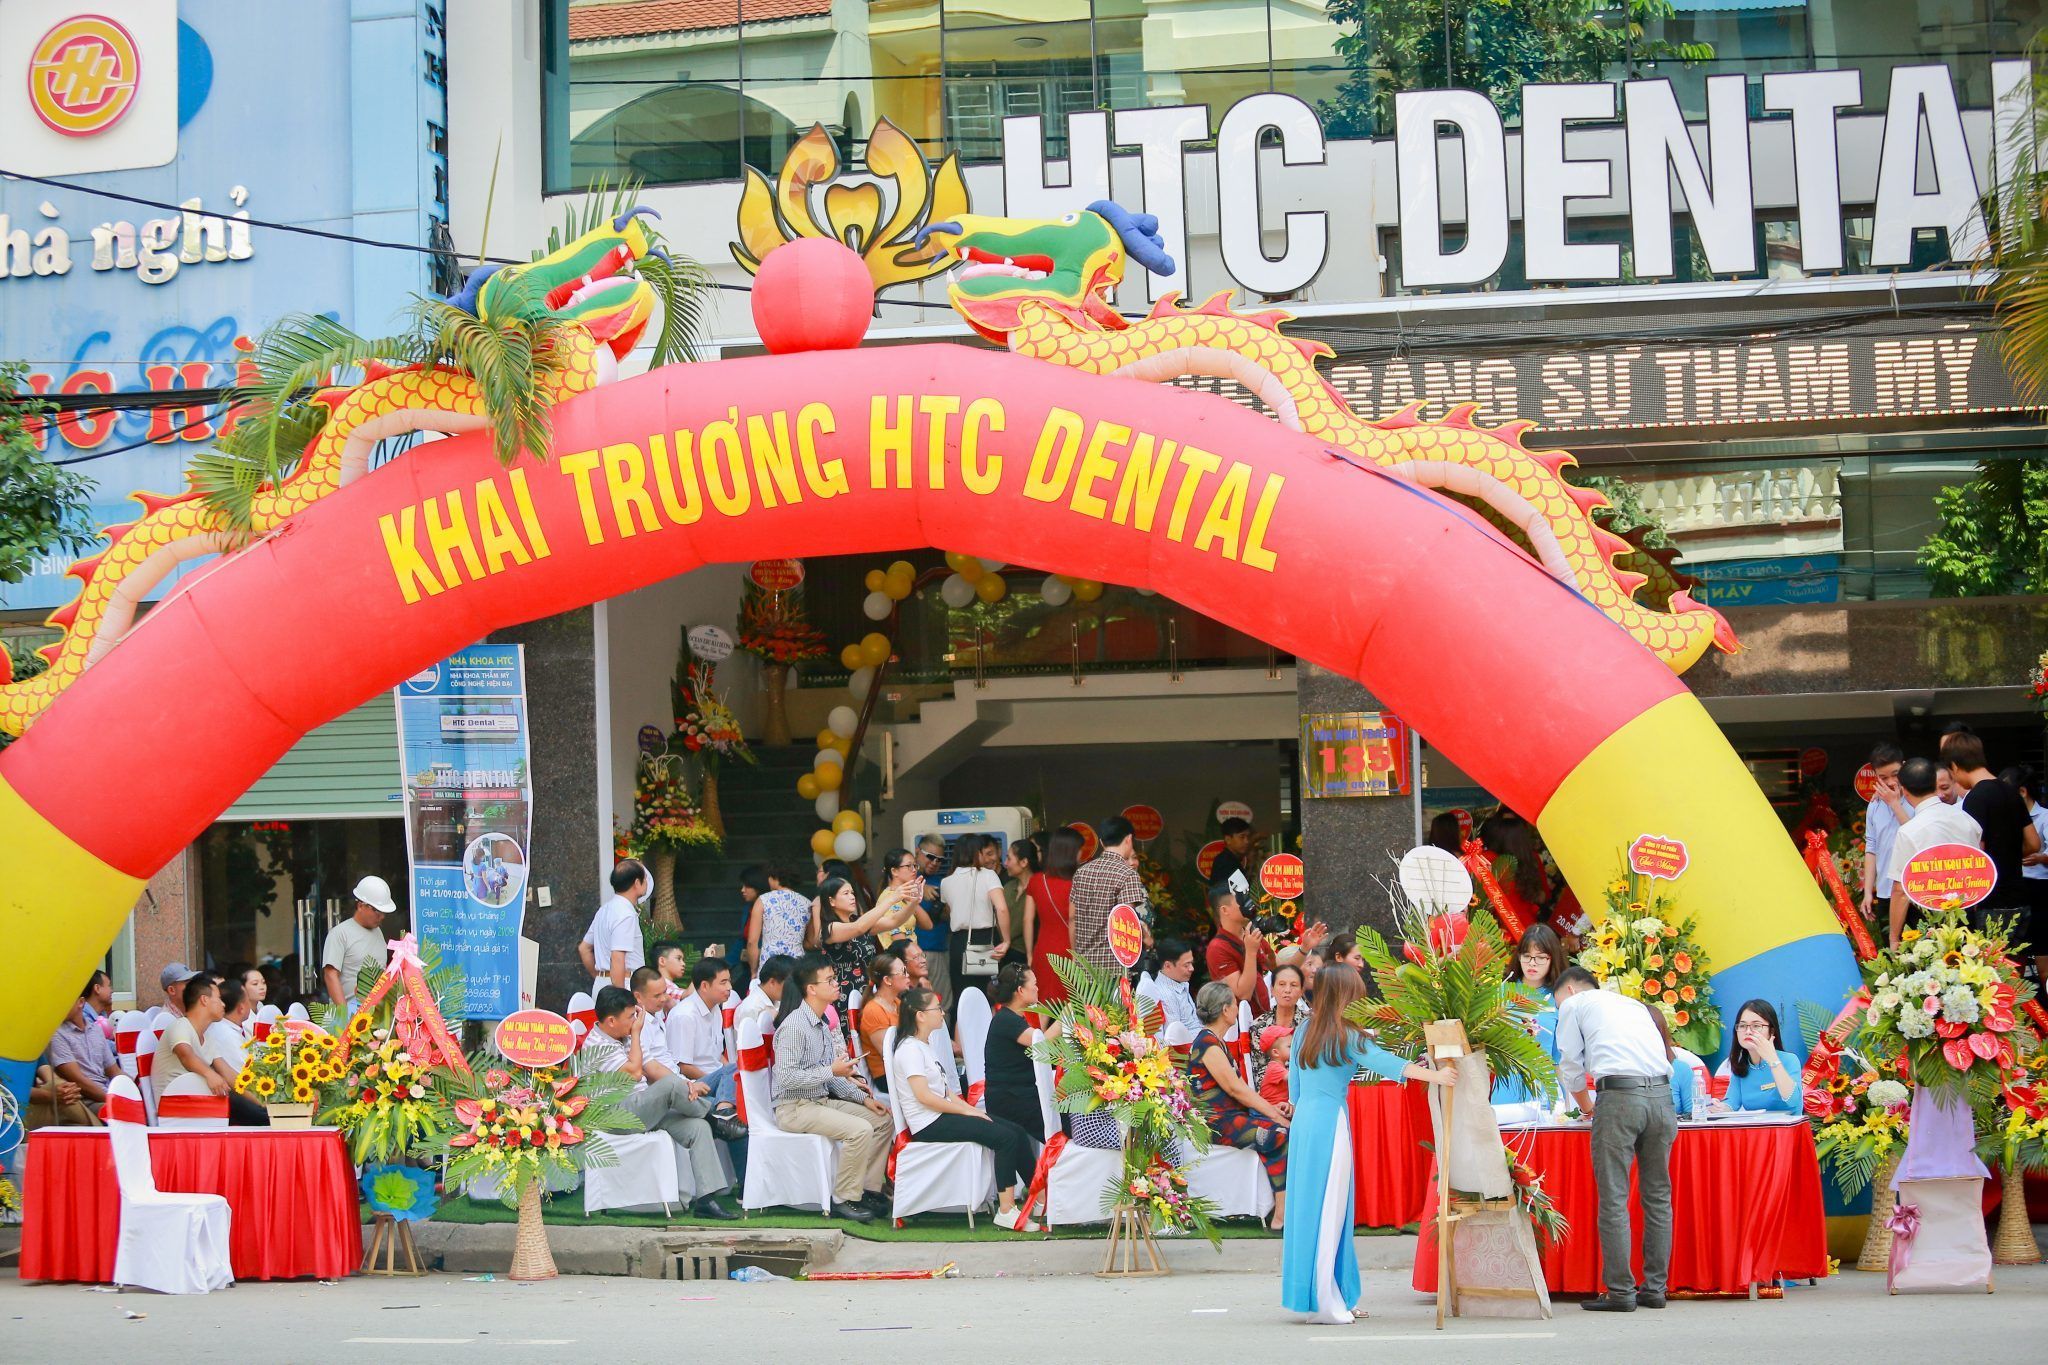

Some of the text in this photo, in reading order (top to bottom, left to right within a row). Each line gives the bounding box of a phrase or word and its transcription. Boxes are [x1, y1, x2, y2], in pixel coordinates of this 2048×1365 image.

[1001, 90, 1331, 305] HTC
[91, 185, 255, 285] nghỉ
[378, 467, 552, 606] KHAI
[869, 395, 1006, 495] HTC
[1022, 406, 1286, 573] DENTAL
[469, 656, 494, 665] KHOA
[497, 656, 514, 665] HTC
[452, 719, 466, 727] HTC
[1318, 745, 1392, 774] 135
